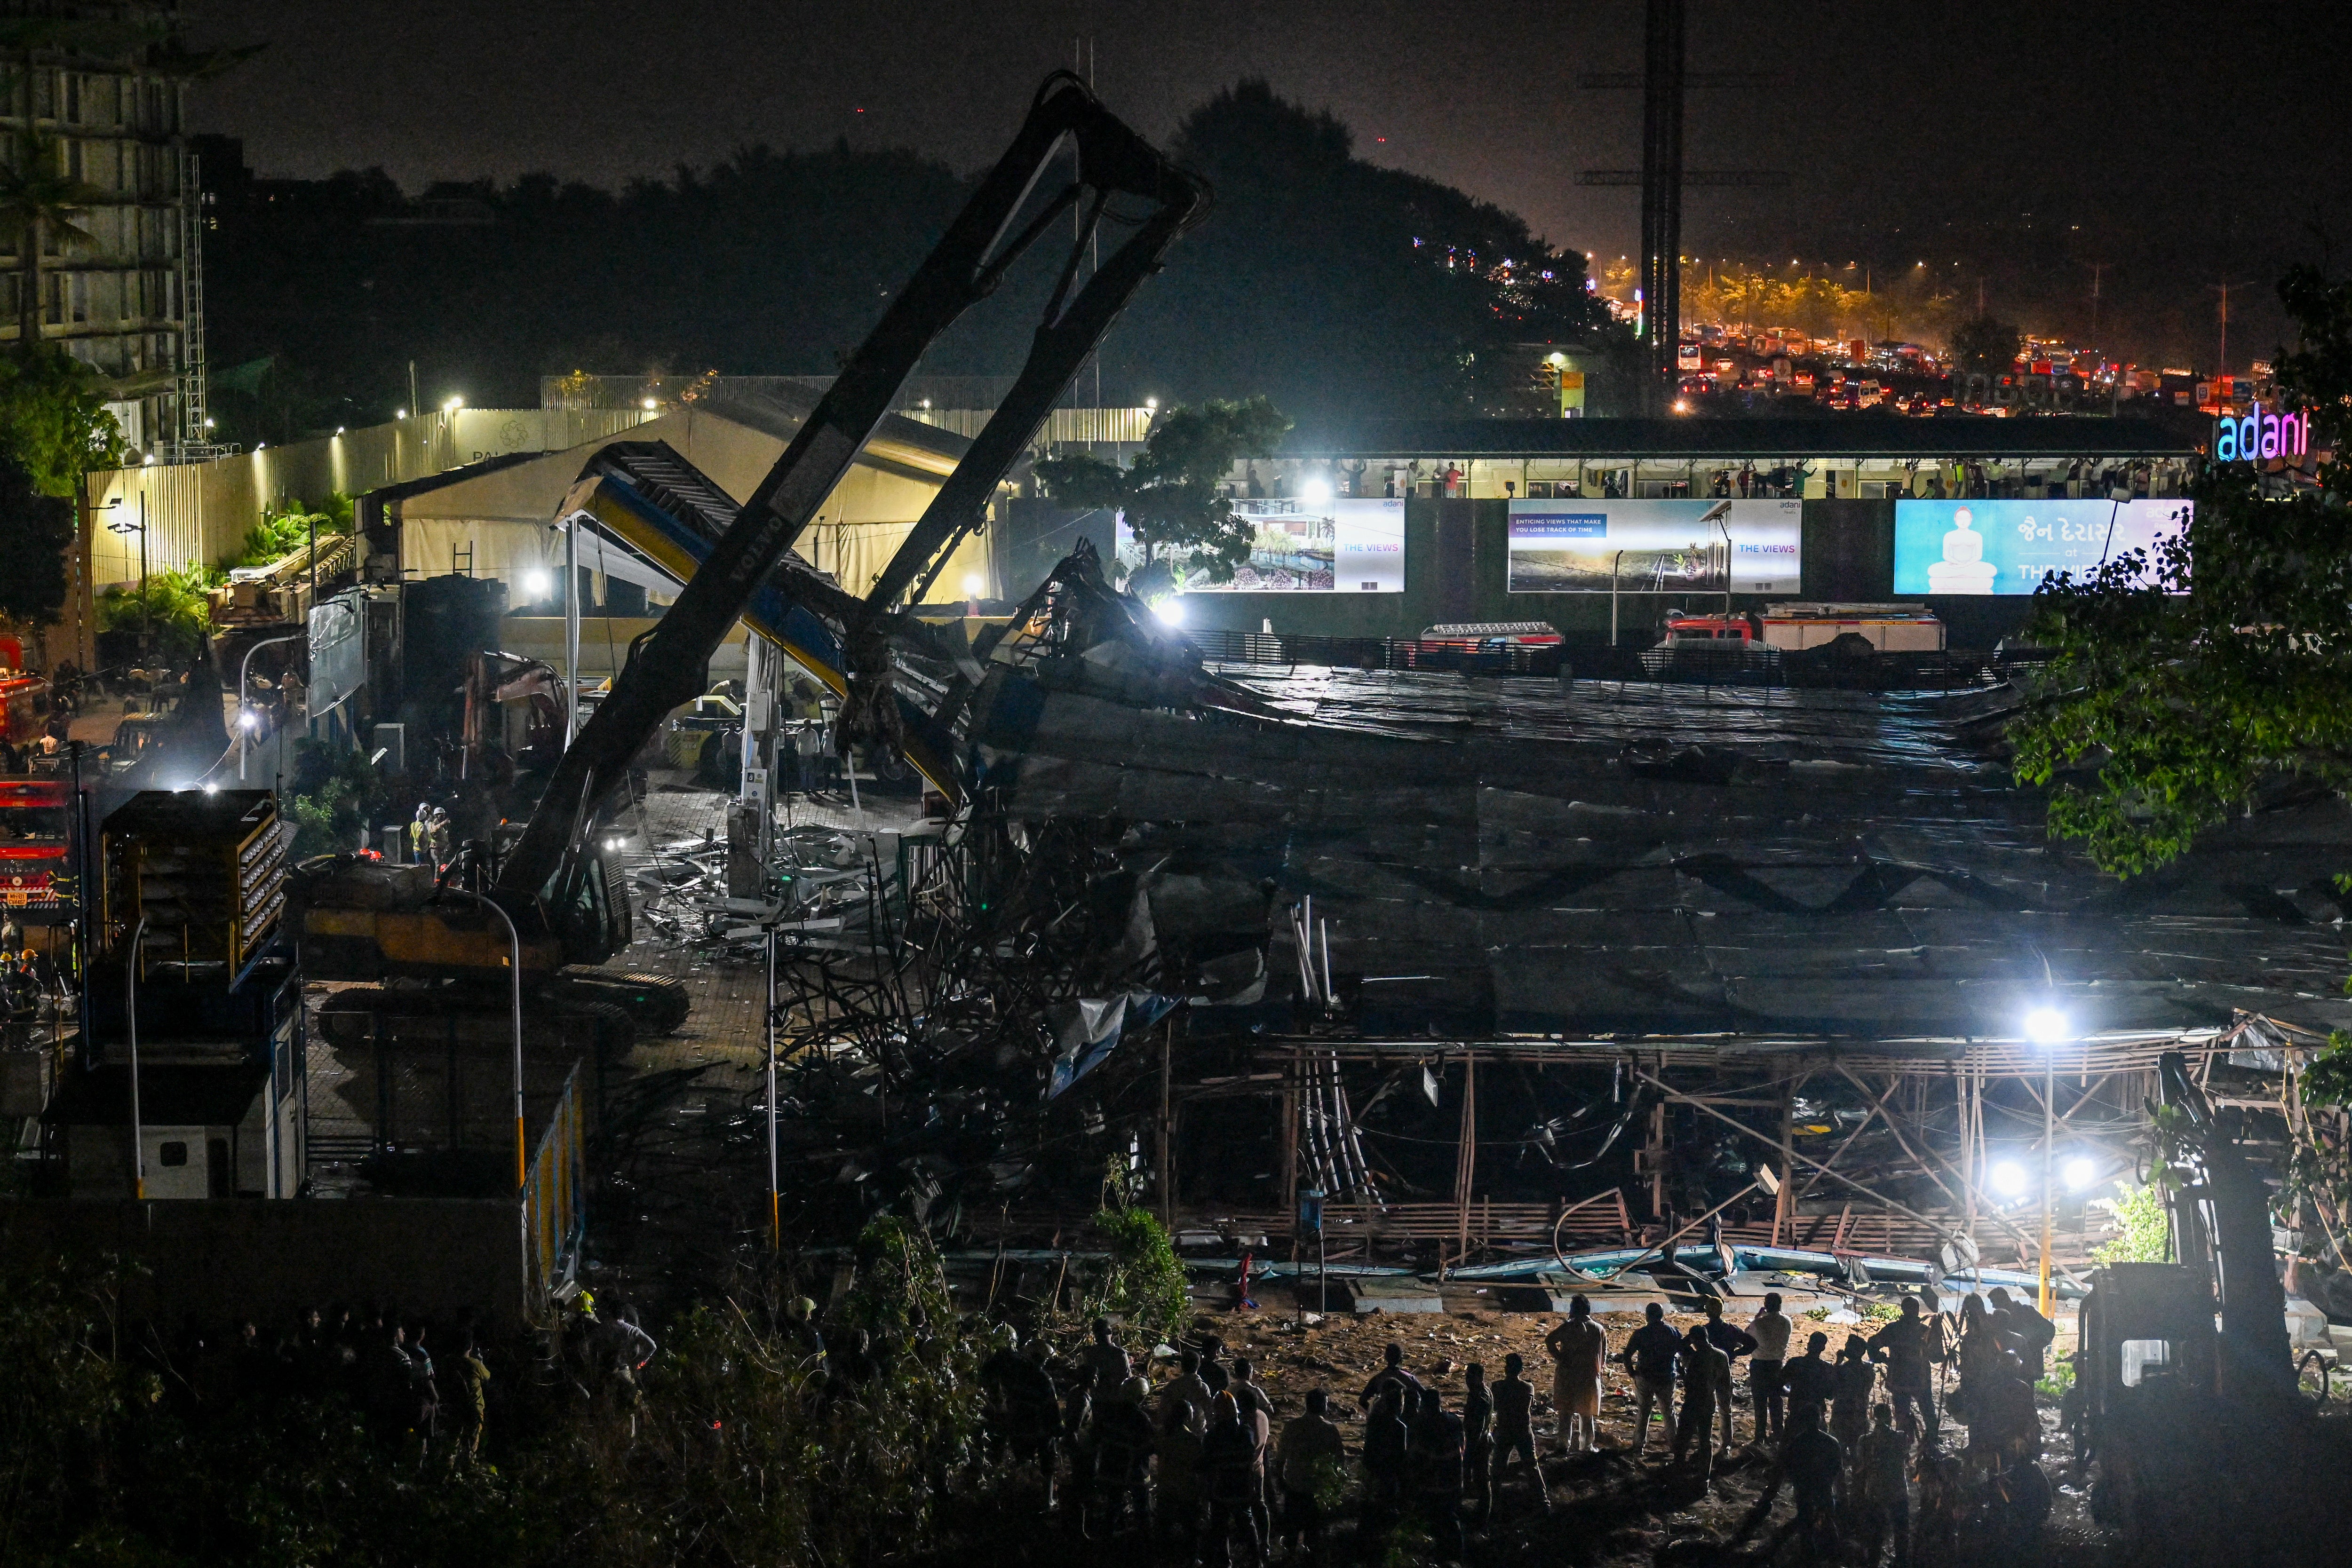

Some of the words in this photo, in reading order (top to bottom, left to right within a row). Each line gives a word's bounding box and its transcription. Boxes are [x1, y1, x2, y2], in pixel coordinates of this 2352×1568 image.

[2217, 401, 2308, 462] adani
[729, 516, 783, 582] VOLVO
[2018, 515, 2054, 542] જૈન
[2065, 548, 2078, 557] at
